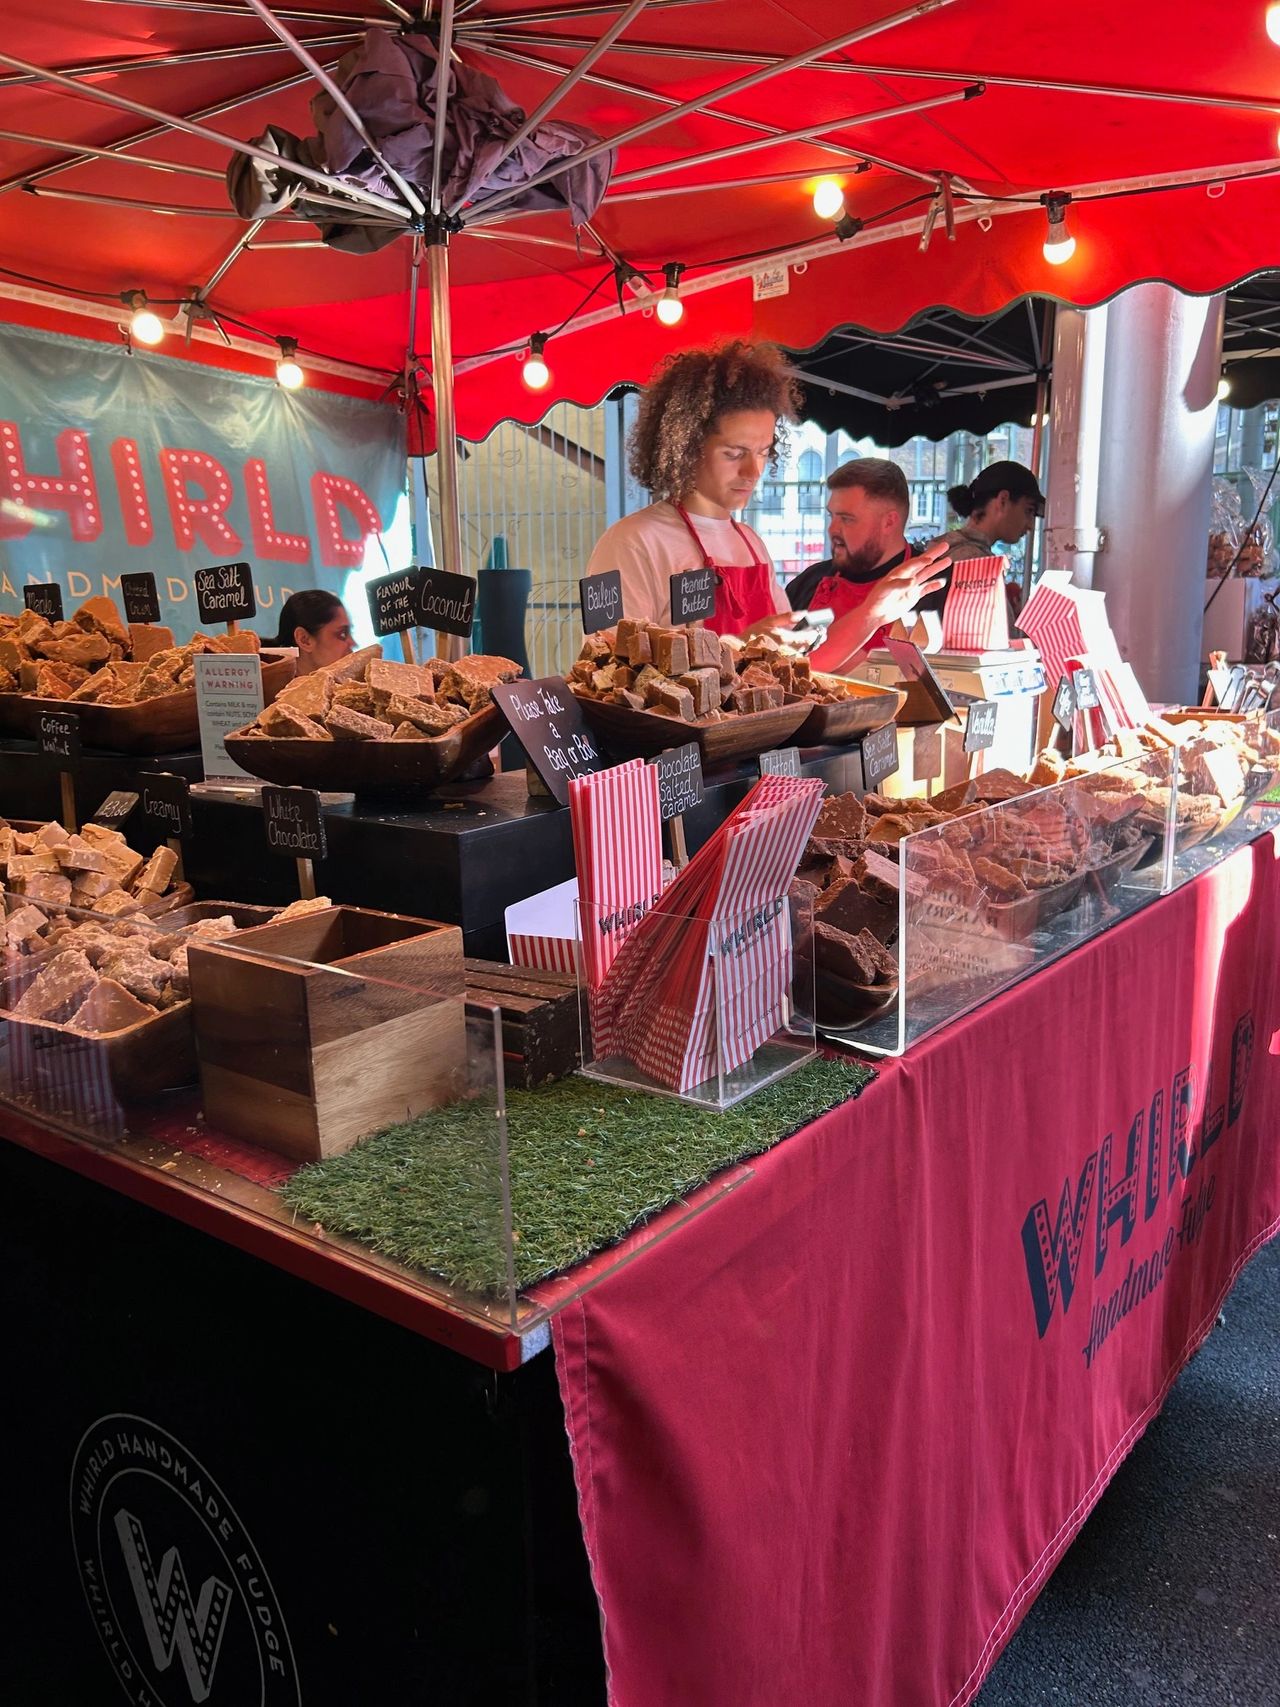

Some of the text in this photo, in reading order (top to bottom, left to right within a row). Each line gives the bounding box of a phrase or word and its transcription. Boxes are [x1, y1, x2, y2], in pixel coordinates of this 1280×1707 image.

[0, 419, 382, 568] HIRLD
[198, 566, 241, 591] Sea Salt
[377, 576, 415, 598] FLAVOUR
[681, 571, 711, 594] Peanut
[955, 578, 997, 590] WHIRLD
[202, 586, 248, 609] Caramel
[381, 595, 409, 613] OF THE
[421, 579, 471, 623] Coconut
[588, 581, 619, 619] Baileys
[682, 595, 711, 615] Butter
[207, 681, 253, 689] WARNING
[510, 687, 564, 720] Please Take
[41, 717, 71, 735] Coffee
[549, 722, 561, 738] a
[567, 746, 579, 763] or
[572, 734, 598, 760] Box
[876, 731, 892, 752] Salt
[543, 745, 576, 779] Bag
[869, 746, 897, 777] Caramel
[660, 772, 693, 802] Salted
[143, 788, 182, 833] Creamy
[269, 794, 303, 822] White
[269, 820, 319, 850] Chocolate
[721, 897, 784, 956] WHIRLD
[79, 1432, 286, 1677] WHIRLD HANDMADE FUDGE
[83, 1559, 133, 1680] WHIRLD
[113, 1507, 234, 1704] W
